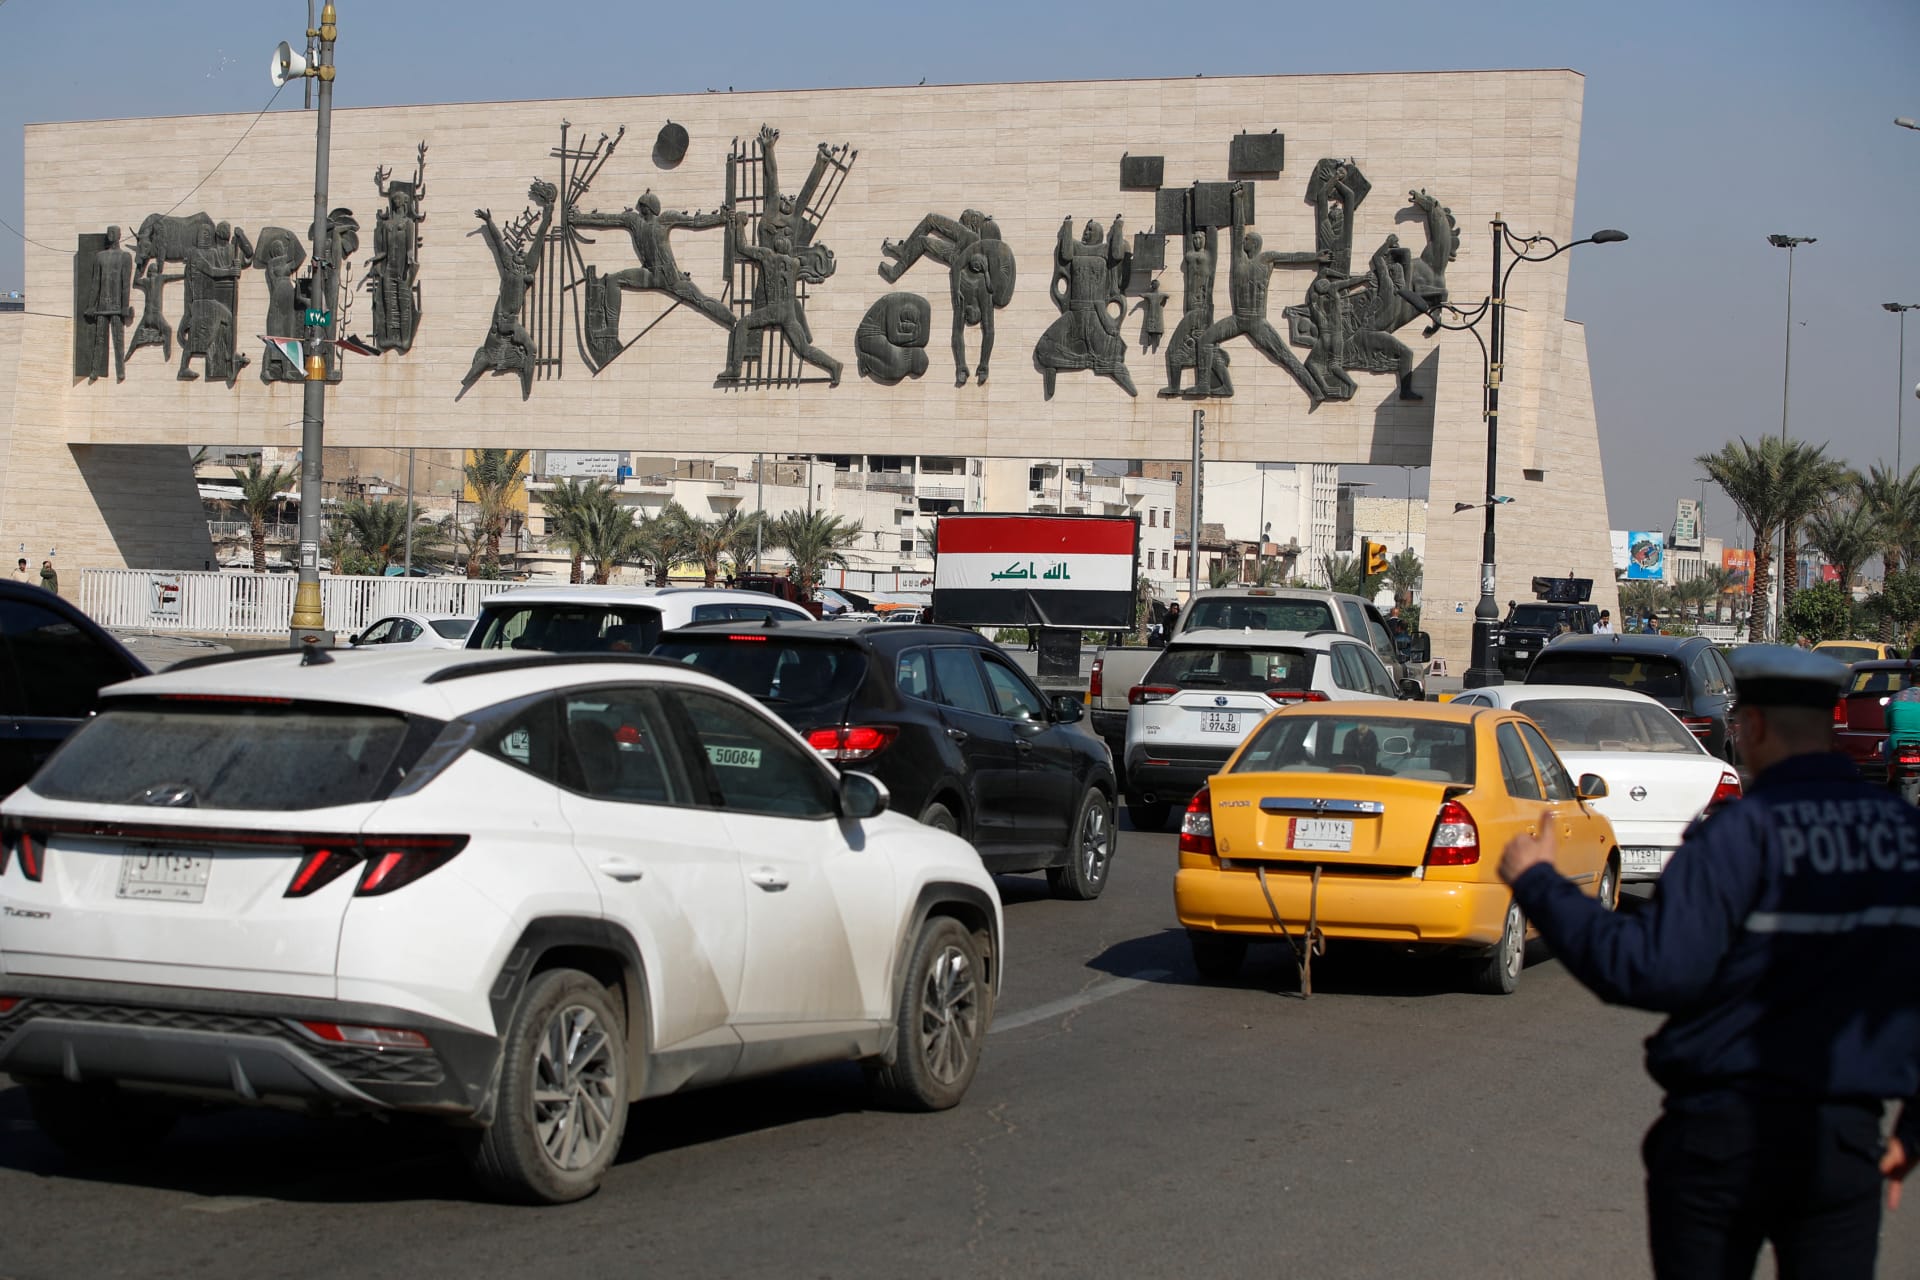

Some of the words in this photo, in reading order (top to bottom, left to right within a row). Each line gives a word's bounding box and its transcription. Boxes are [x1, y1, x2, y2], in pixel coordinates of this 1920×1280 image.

[1210, 713, 1220, 722] 11
[1228, 713, 1234, 722] D
[1209, 722, 1236, 732] 97438
[716, 748, 756, 766] 50084
[1780, 823, 1920, 876] POLICE
[4, 906, 51, 919] Tucson
